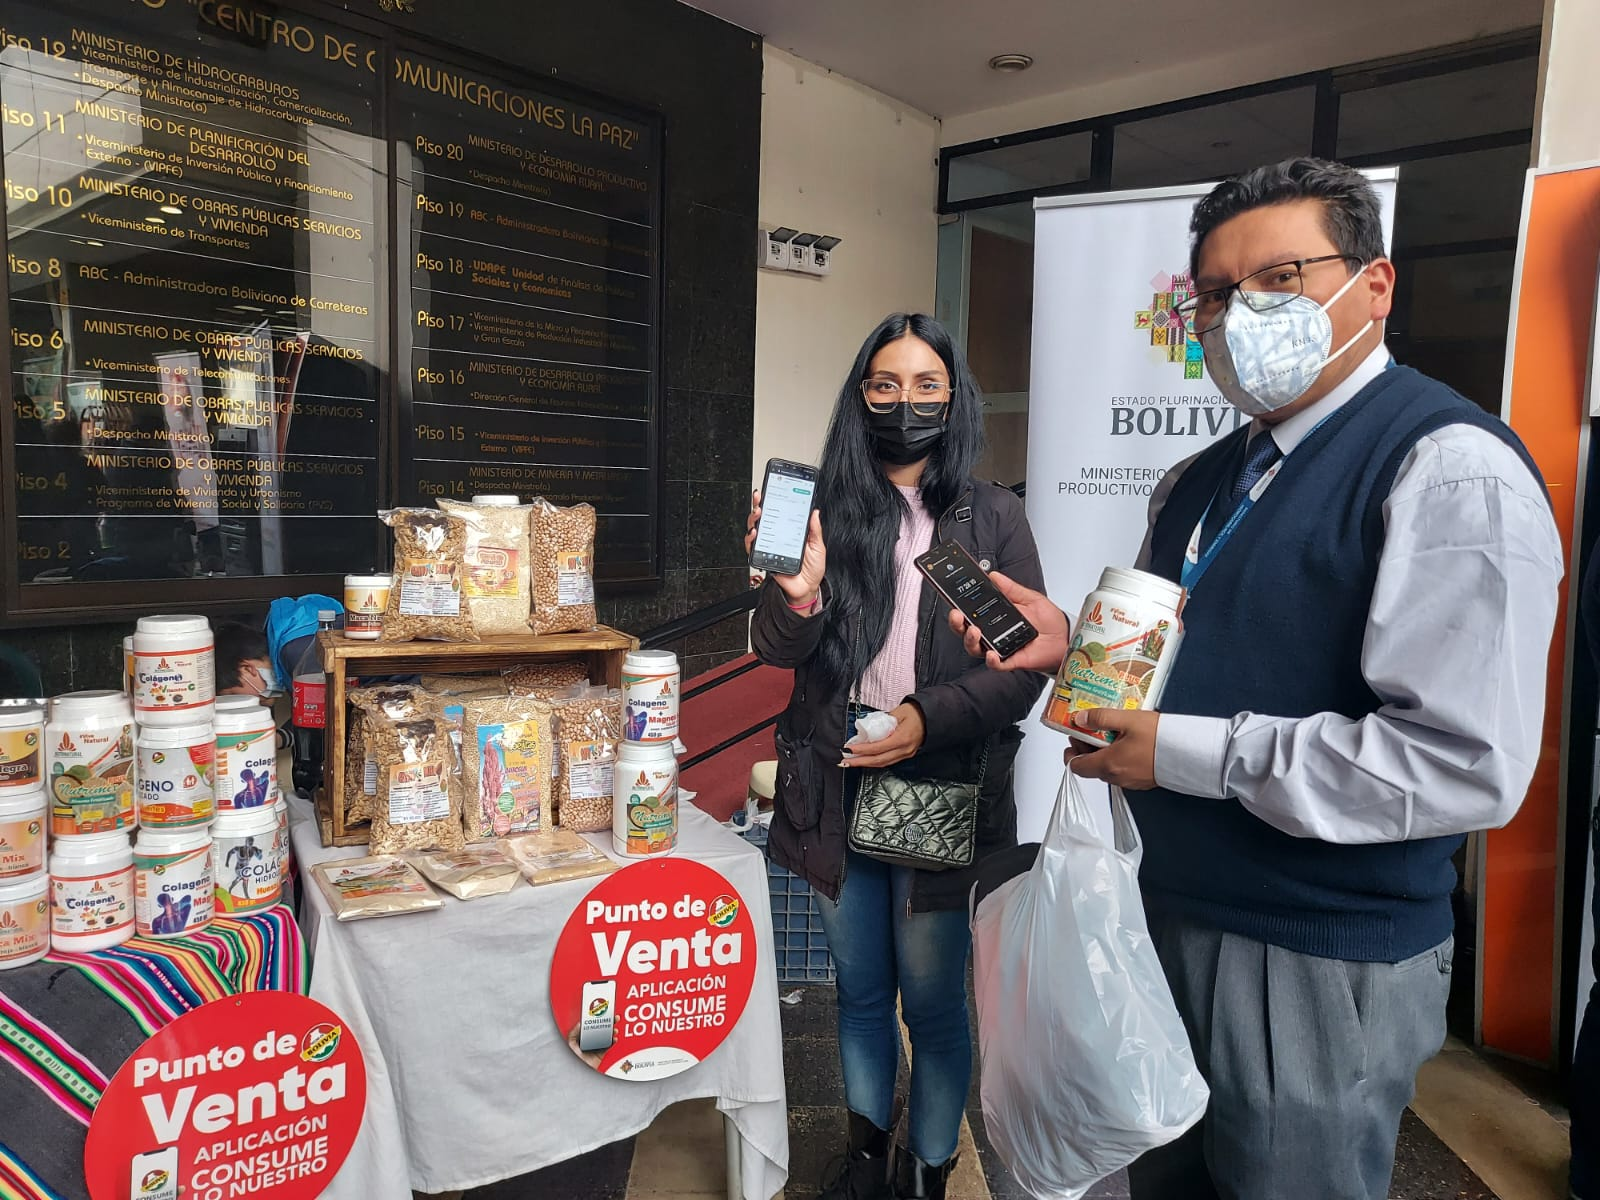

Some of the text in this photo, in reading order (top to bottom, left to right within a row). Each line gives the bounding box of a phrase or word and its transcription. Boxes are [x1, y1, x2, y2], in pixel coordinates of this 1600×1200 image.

[0, 28, 66, 62] iso 12
[72, 28, 299, 100] MINISTERIO DE HIDROCARBUROS
[82, 47, 163, 75] Viceministerio
[166, 70, 181, 80] de
[82, 59, 147, 85] Transporte
[228, 98, 242, 108] de
[82, 73, 207, 114] Despacho Ministro(a)
[324, 34, 357, 68] DE
[572, 112, 593, 139] LA
[2, 104, 65, 135] iso 11
[75, 100, 311, 166] MINISTERIO DE PLANIFICACIÓN DEL
[190, 141, 276, 171] DESARROLLO
[416, 135, 464, 161] Piso 20
[468, 134, 523, 158] MINISTERIO
[526, 150, 537, 161] DE
[86, 149, 183, 179] Externo (VIPFE)
[86, 134, 165, 160] Viceministerio
[169, 153, 183, 164] de
[187, 155, 234, 175] Inversión
[237, 167, 272, 183] Pública
[284, 177, 354, 201] Financiamiento
[5, 179, 72, 208] iso 10
[416, 194, 464, 218] Piso 19
[80, 176, 362, 240] MINISTERIO DE OBRAS PÚBLICAS SERVICIOS
[88, 212, 250, 250] Viceministerio de Transportes
[199, 214, 269, 238] Y VIVIENDA
[8, 255, 61, 278] iso 8
[416, 253, 463, 274] Piso 18
[512, 267, 544, 282] Unidad
[79, 265, 369, 315] ABC Administradora Boliviana de Carreteras
[472, 273, 511, 289] Sociales
[417, 310, 465, 331] Piso 17
[11, 328, 63, 350] iso 6
[84, 319, 168, 340] MINISTERIO
[173, 328, 191, 342] DE
[195, 331, 241, 347] OBRAS
[305, 343, 363, 361] SERVICIOS
[92, 358, 170, 375] Viceministerio
[174, 366, 188, 376] de
[202, 347, 272, 363] Y VIVIENDA
[418, 367, 465, 385] Piso 16
[13, 401, 66, 420] iso 5
[85, 388, 169, 406] MINISTERIO
[173, 394, 192, 407] DE
[196, 396, 242, 411] OBRAS
[1111, 396, 1156, 406] ESTADO
[203, 411, 272, 427] Y VIVIENDA
[93, 428, 151, 441] Despacho
[418, 424, 465, 441] Piso 15
[87, 453, 171, 469] MINISTERIO
[175, 457, 193, 470] DE
[197, 458, 243, 471] OBRAS
[1081, 467, 1167, 481] MINISTERIO
[17, 472, 68, 490] iso 4
[216, 475, 273, 487] VIVIENDA
[418, 480, 465, 496] Piso 14
[1058, 482, 1153, 497] PRODUCTIVO
[628, 699, 667, 709] Colageno
[586, 894, 707, 925] Punto de
[711, 903, 737, 922] BOLIVIA
[591, 928, 742, 977] Venta
[626, 973, 727, 999] APLICACIÓN
[624, 994, 727, 1023] CONSUME
[624, 1012, 726, 1038] LO NUESTRO
[306, 1030, 339, 1057] BOLIVIA
[133, 1030, 298, 1088] Punto de
[141, 1062, 347, 1145] Venta
[193, 1114, 328, 1166] APLICACIÓN
[191, 1136, 329, 1190] CONSUME
[229, 1155, 328, 1200] NUESTRO
